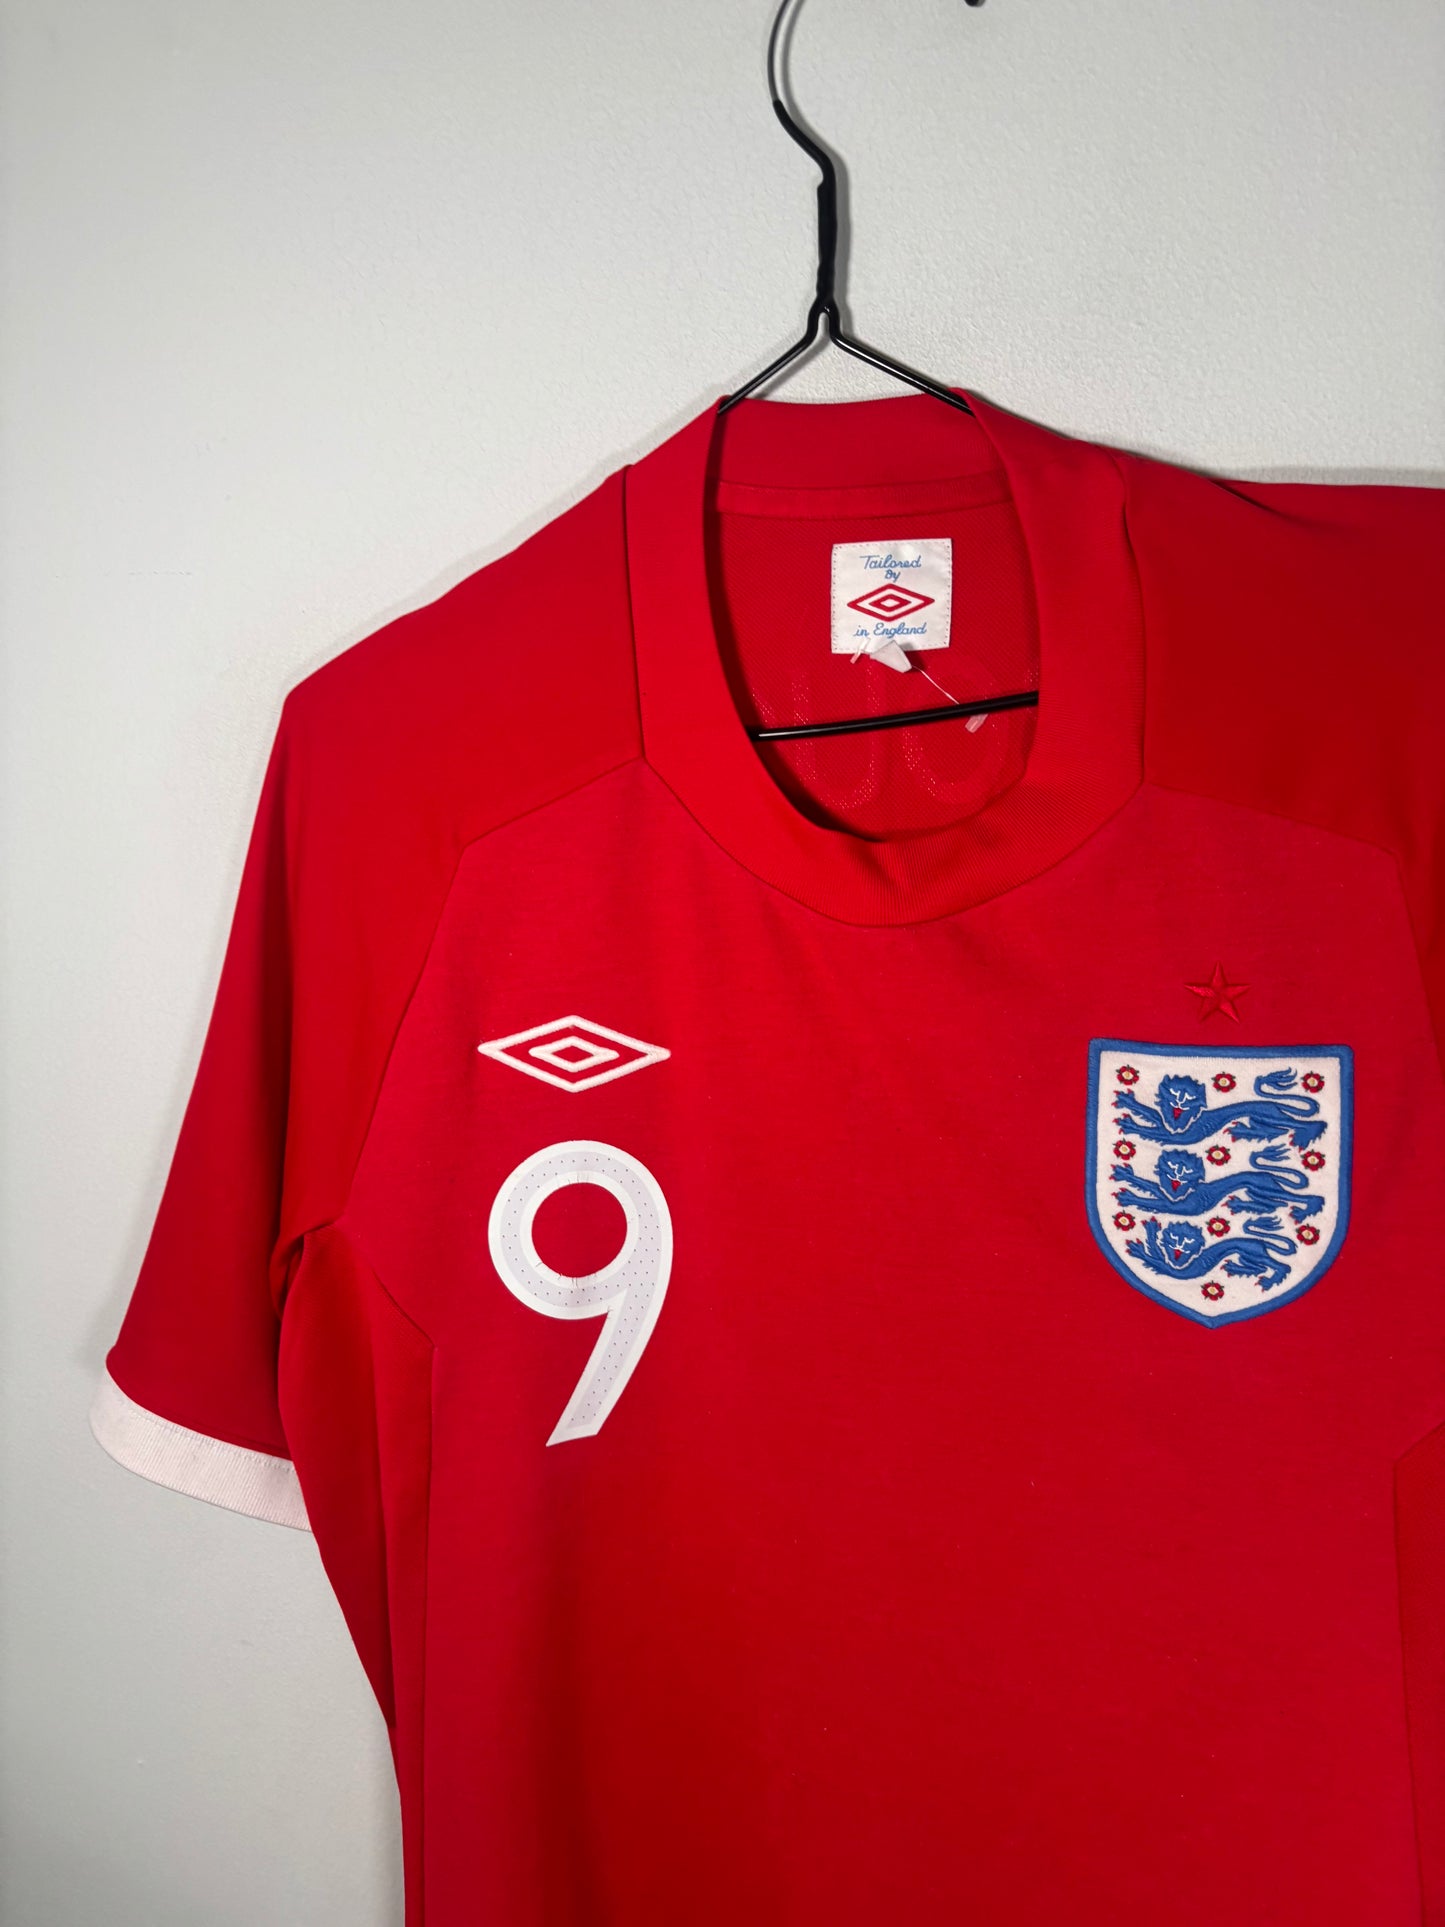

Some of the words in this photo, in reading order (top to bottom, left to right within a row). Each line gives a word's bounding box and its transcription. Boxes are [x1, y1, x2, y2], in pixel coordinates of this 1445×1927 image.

[860, 554, 921, 570] Tailored
[853, 625, 869, 637] in
[873, 622, 927, 639] England
[488, 1140, 673, 1447] 9
